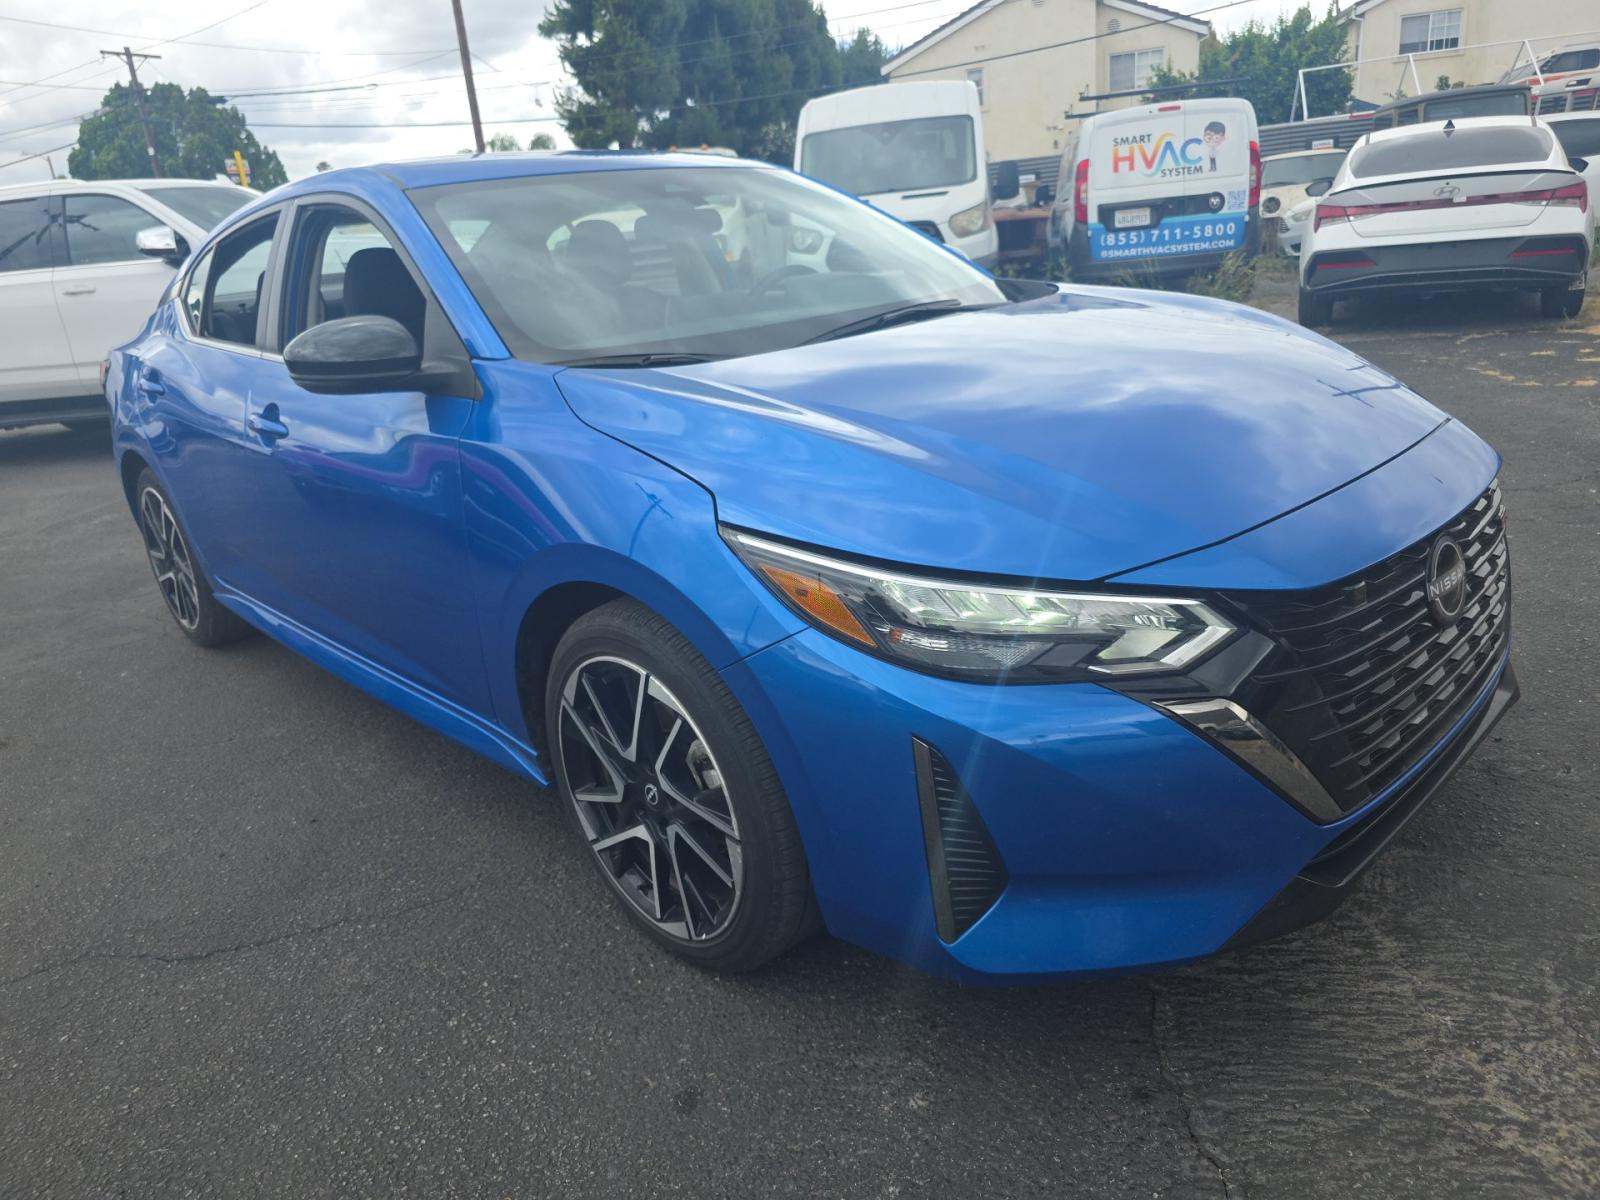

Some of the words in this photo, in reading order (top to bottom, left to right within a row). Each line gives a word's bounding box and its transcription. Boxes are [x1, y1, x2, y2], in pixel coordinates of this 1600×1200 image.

[1112, 133, 1152, 146] SMART
[1112, 132, 1203, 177] HVAC
[1160, 165, 1204, 177] SYSTEM
[1100, 233, 1146, 246] (855)
[1151, 222, 1236, 241] 711-5800
[1429, 569, 1463, 598] NISS
